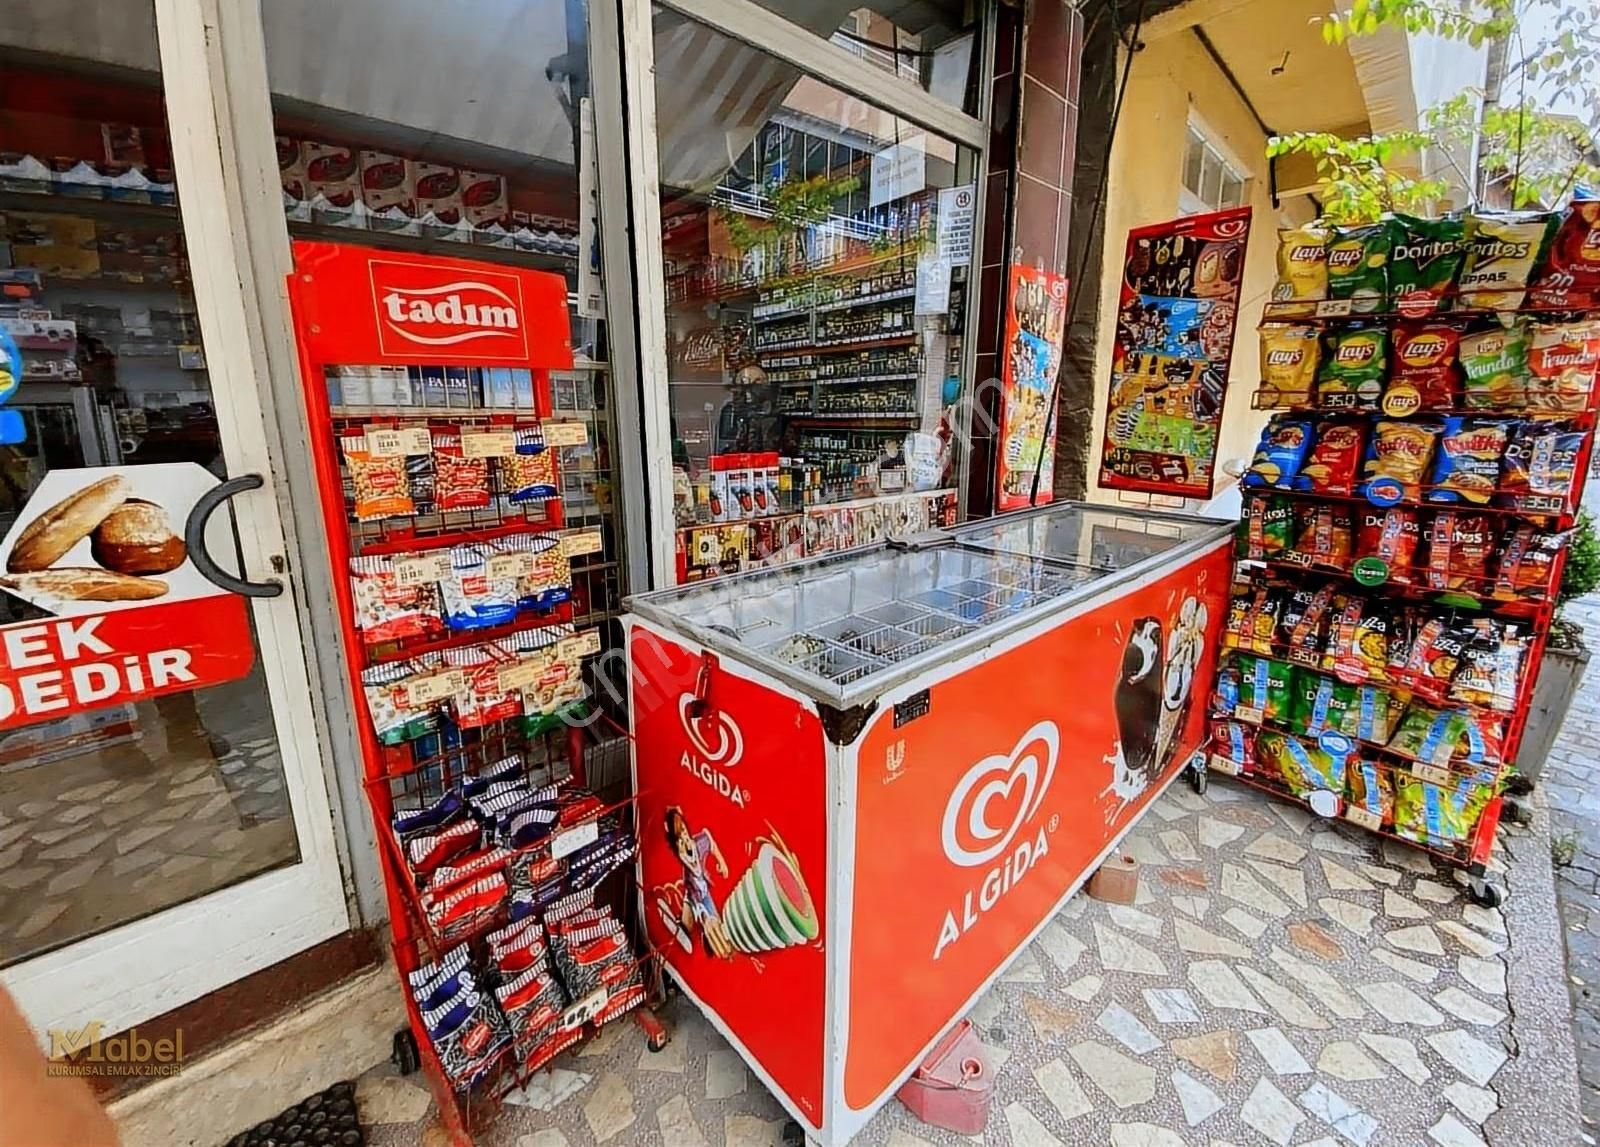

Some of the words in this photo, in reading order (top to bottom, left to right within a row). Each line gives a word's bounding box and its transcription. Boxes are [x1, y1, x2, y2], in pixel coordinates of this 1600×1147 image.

[1328, 249, 1362, 266] Lay's
[1393, 240, 1463, 261] Doritos
[383, 293, 518, 328] tadım
[1268, 350, 1301, 365] Lay's
[1338, 343, 1374, 361] Lay's
[1404, 342, 1443, 357] Lay's
[1387, 394, 1416, 408] Lay's
[3, 615, 115, 670] EK
